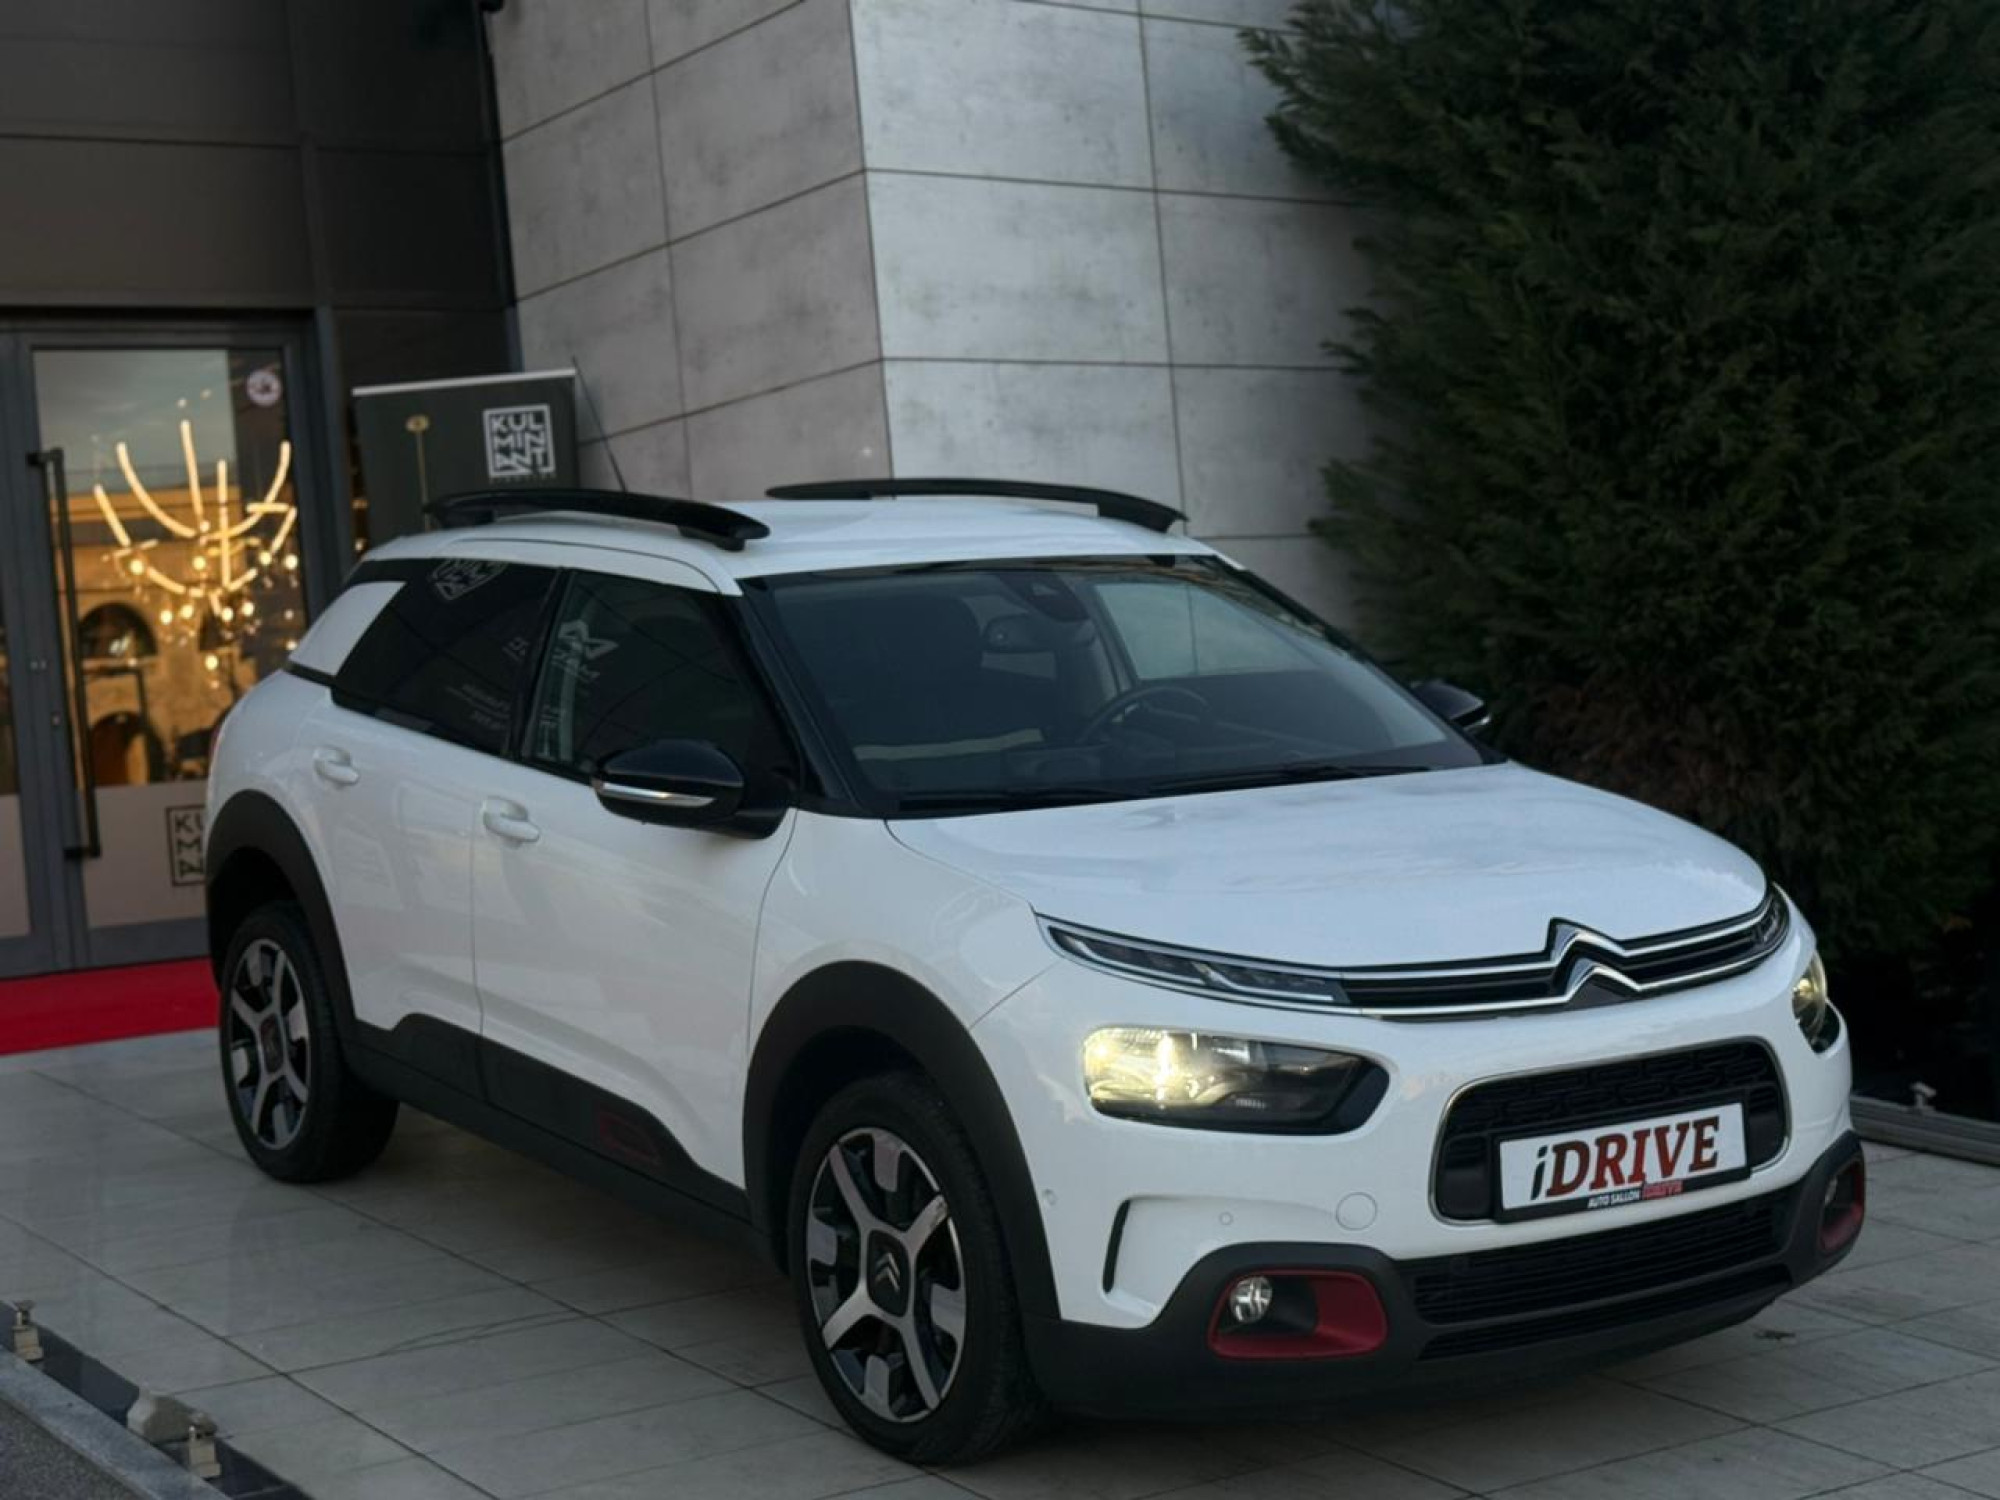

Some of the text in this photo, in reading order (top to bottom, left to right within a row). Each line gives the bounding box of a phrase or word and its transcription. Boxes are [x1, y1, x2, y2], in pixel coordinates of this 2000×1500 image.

[491, 412, 544, 433] KUL
[494, 431, 544, 449] MIN
[1531, 1116, 1719, 1200] iDRIVE
